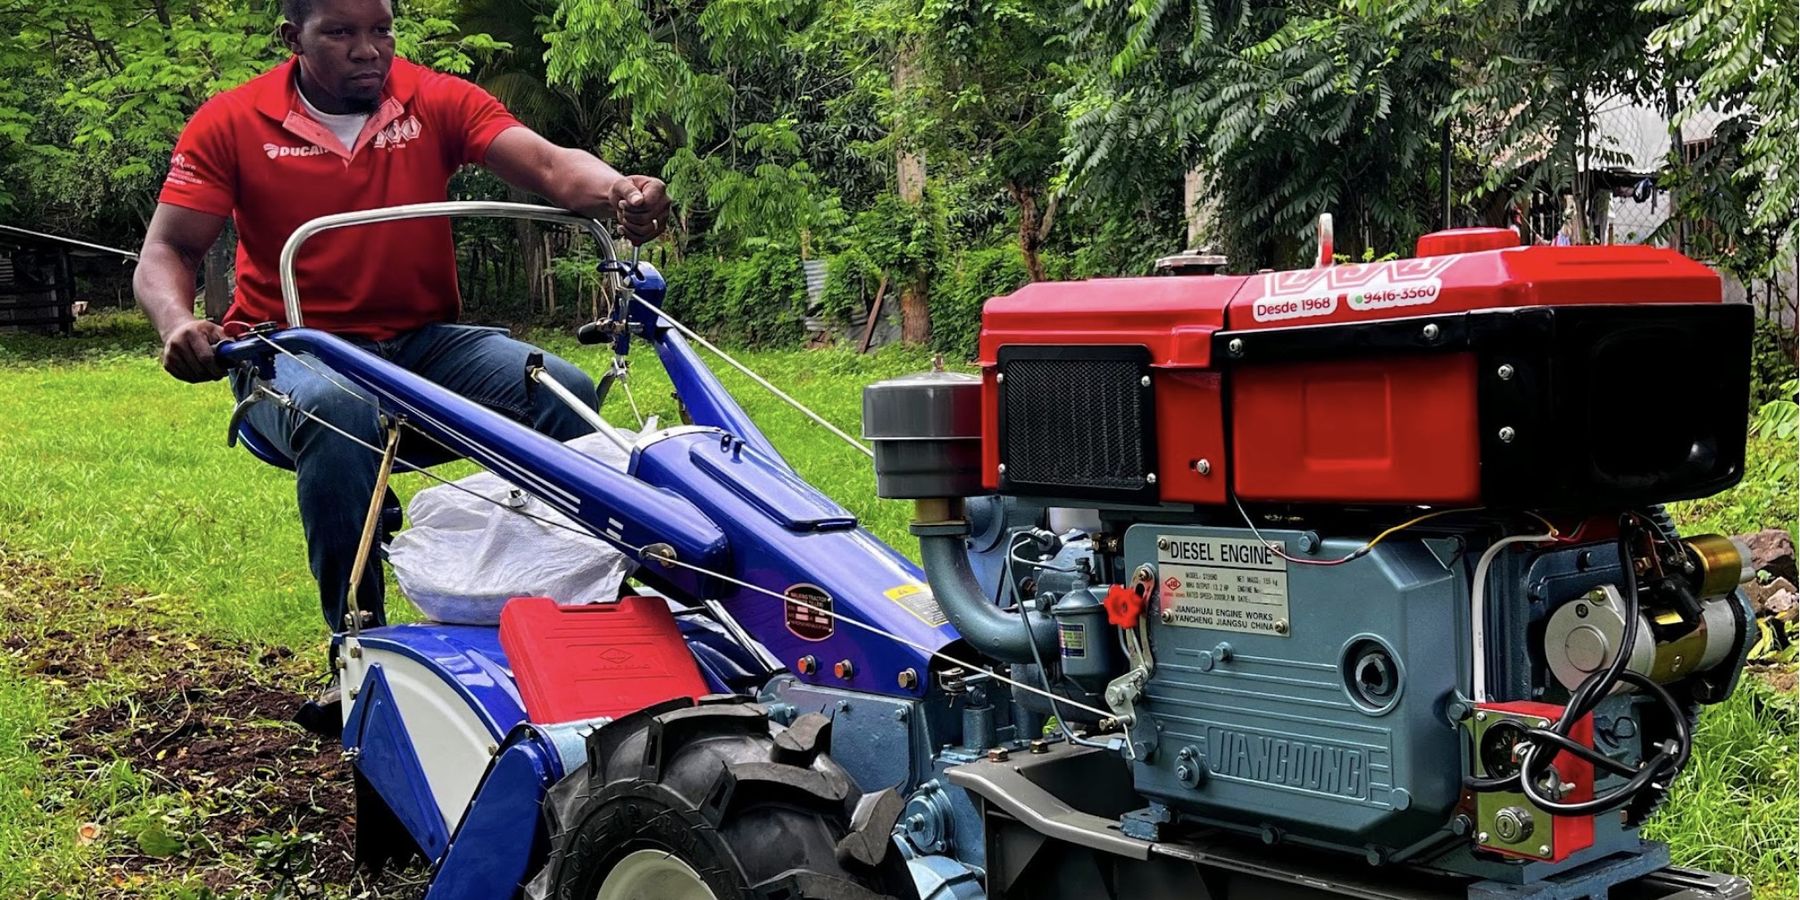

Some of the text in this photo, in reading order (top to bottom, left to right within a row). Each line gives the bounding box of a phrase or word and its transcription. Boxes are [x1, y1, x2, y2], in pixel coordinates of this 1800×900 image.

[1363, 285, 1436, 304] 9416-3560
[1257, 297, 1331, 317] Desde 1968
[1171, 541, 1273, 565] DIESEL ENGINE
[1175, 606, 1274, 621] JIANGHUAI ENGINE WORKS
[1175, 615, 1274, 631] YANCHENG JIANGSU CHINA
[1212, 730, 1363, 797] JIANGDONG
